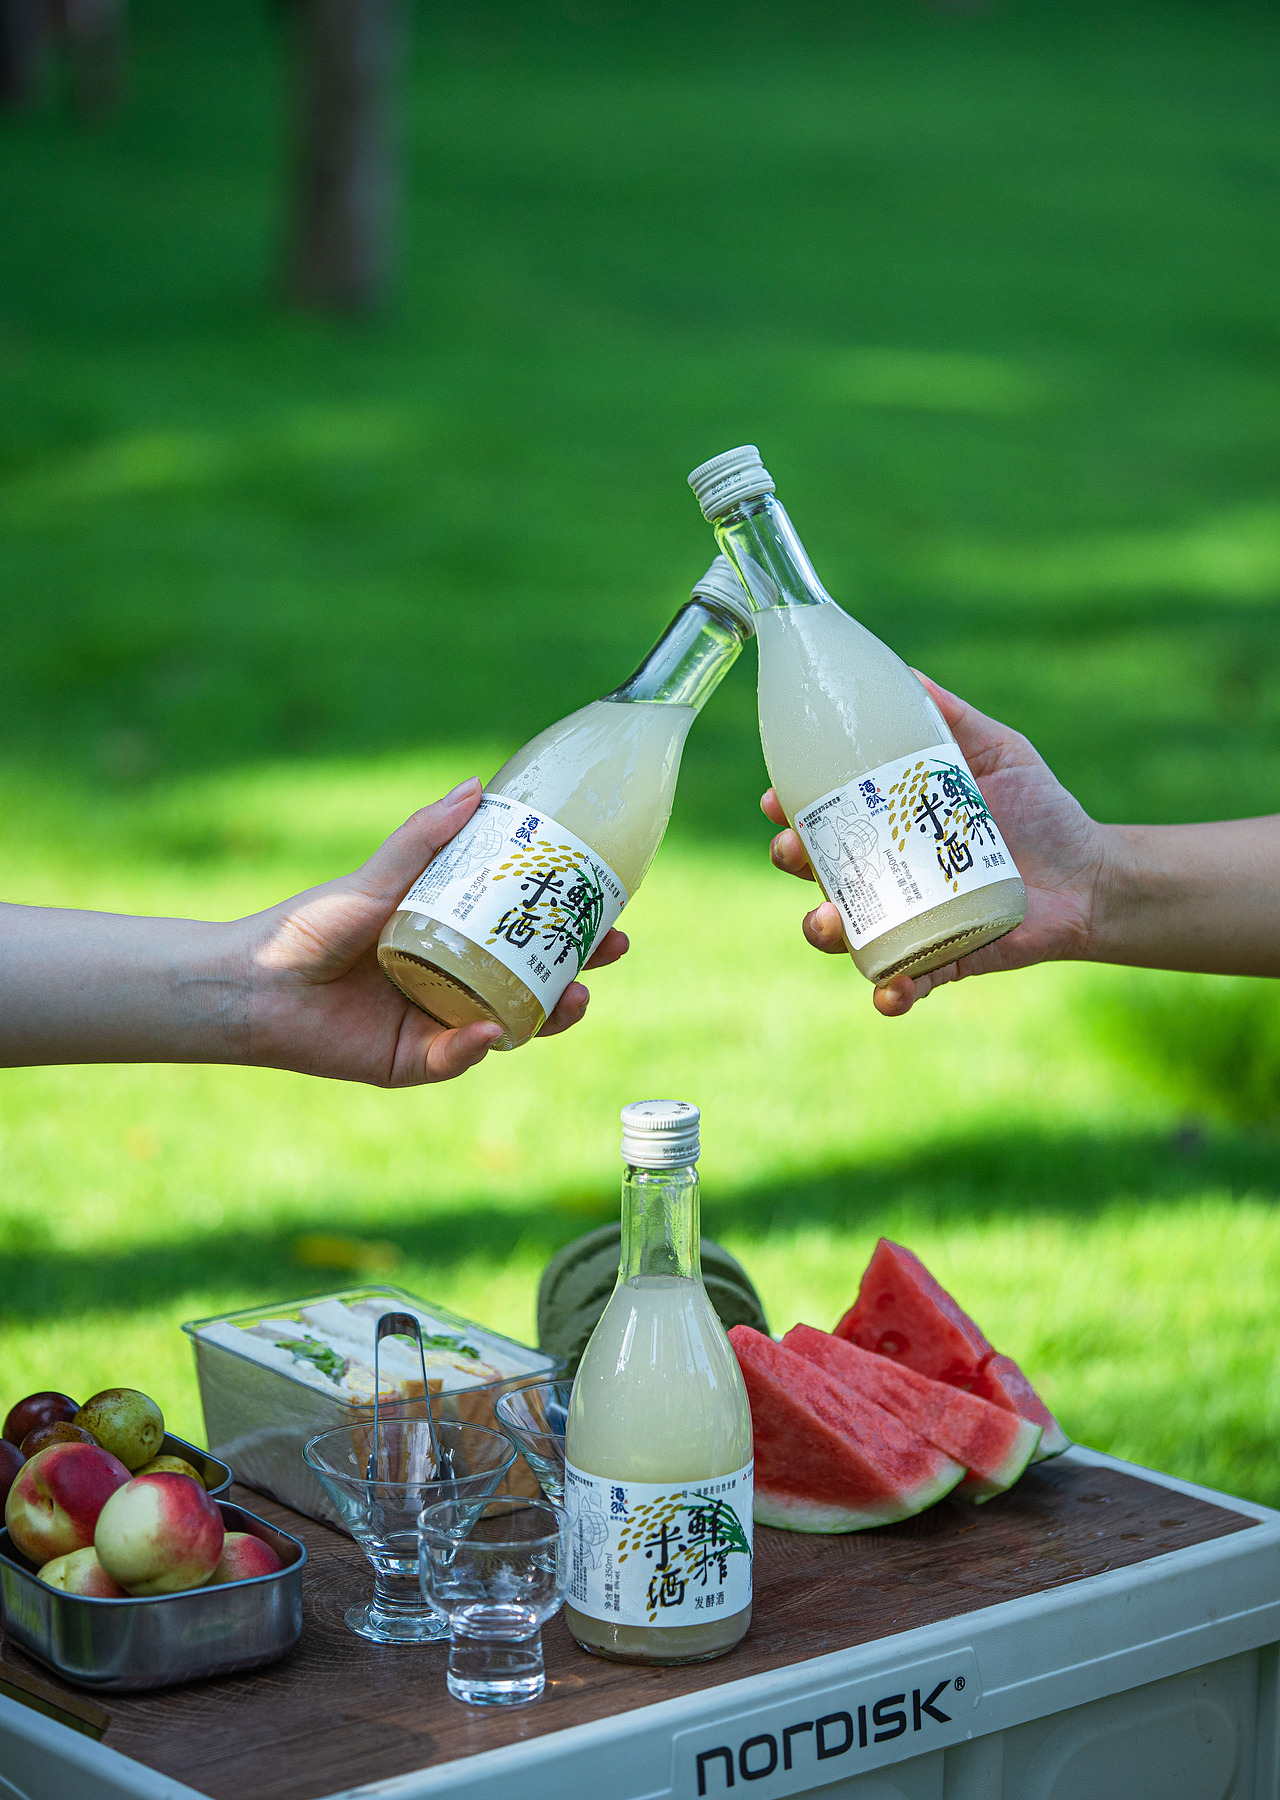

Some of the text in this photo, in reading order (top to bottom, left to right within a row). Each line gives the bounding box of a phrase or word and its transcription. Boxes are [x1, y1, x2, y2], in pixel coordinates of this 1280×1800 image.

[915, 793, 973, 879] 米酒
[495, 870, 564, 948] 米酒
[526, 954, 552, 983] 发酵酒
[645, 1523, 687, 1609] 米酒
[694, 1591, 725, 1610] 发酵酒
